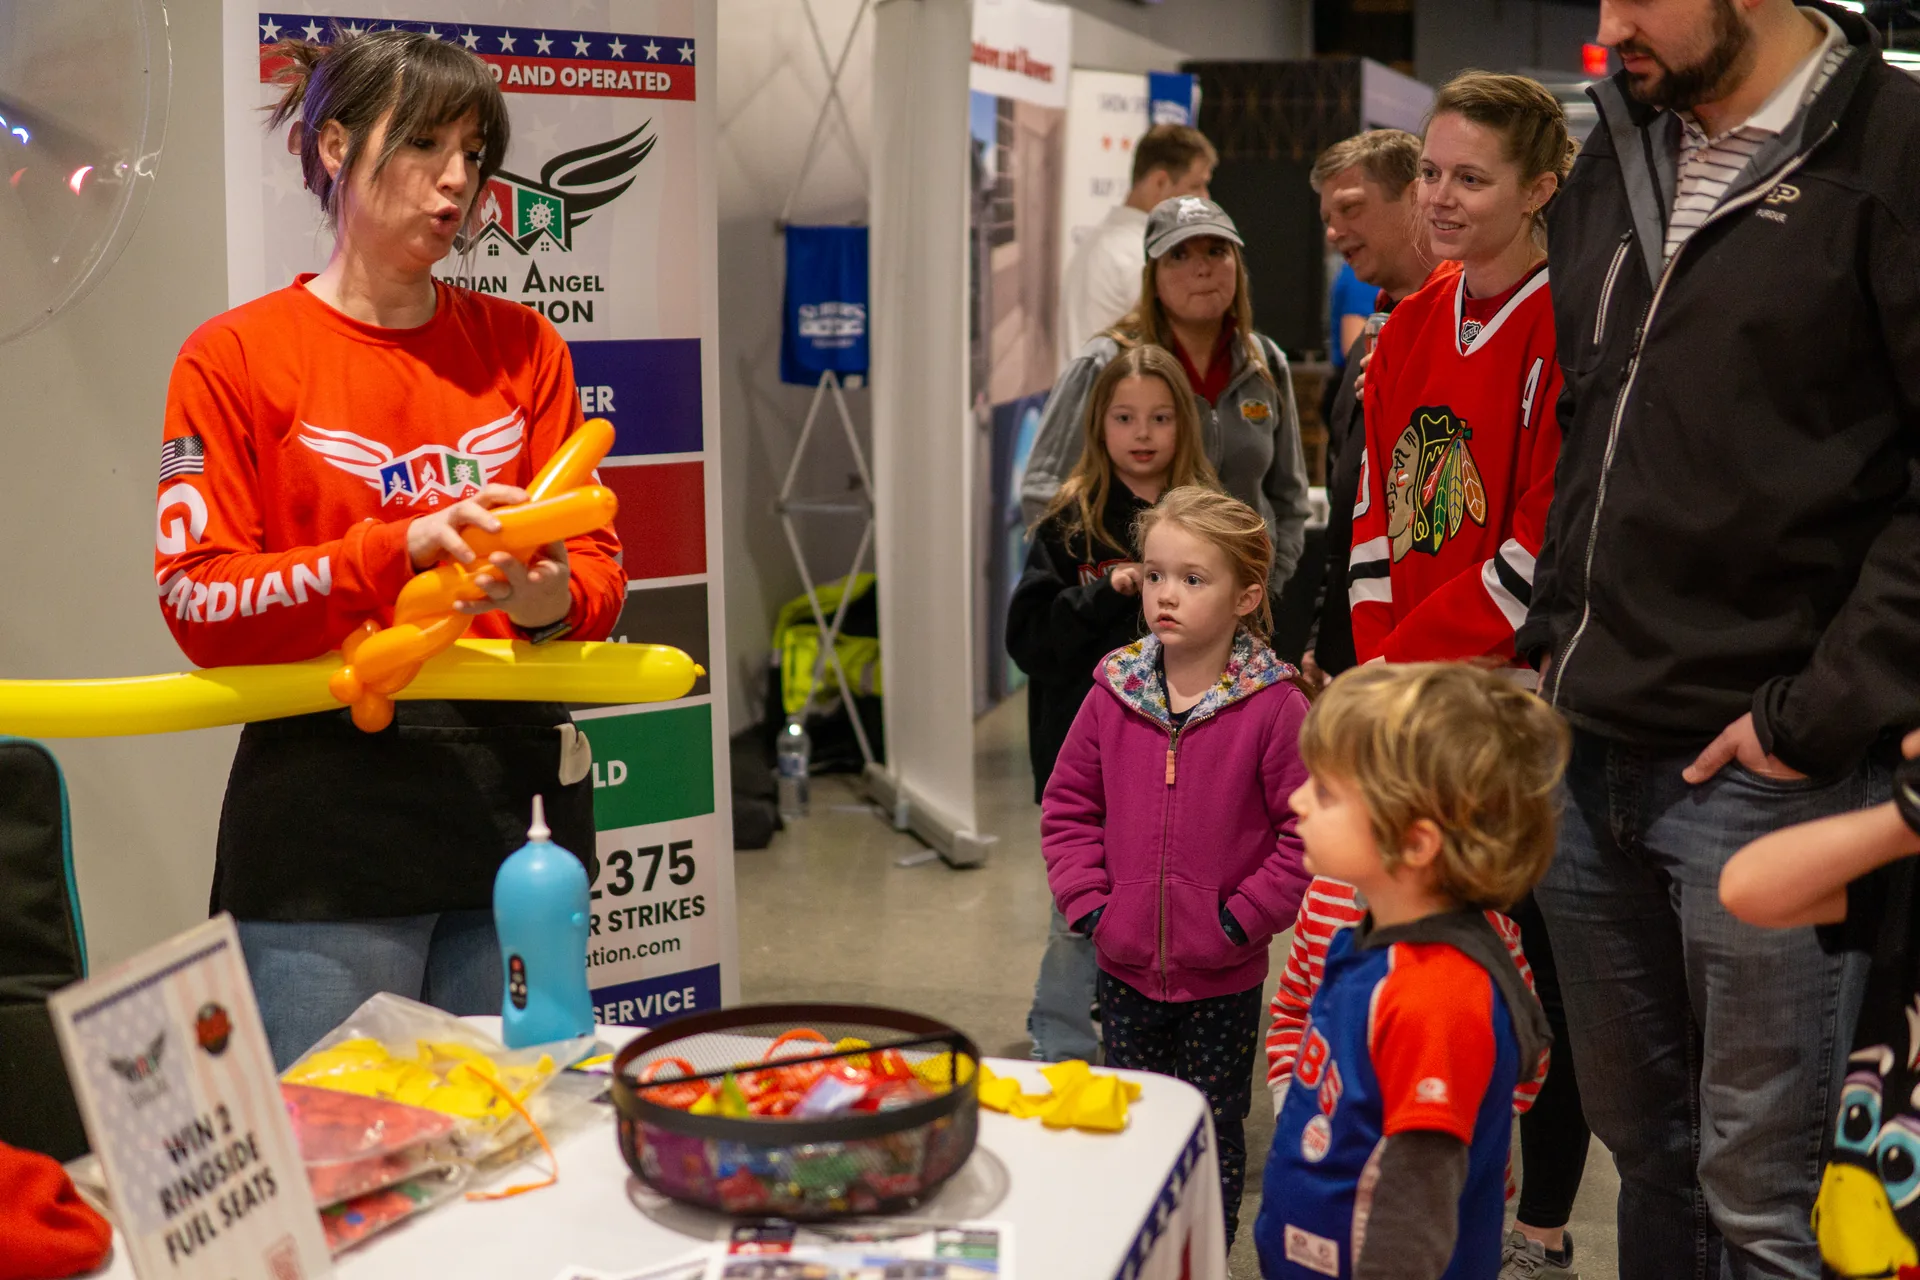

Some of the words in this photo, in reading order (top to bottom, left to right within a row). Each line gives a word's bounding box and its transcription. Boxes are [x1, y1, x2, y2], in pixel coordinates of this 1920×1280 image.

[507, 64, 556, 87] AND
[560, 66, 671, 92] OPERATED
[434, 275, 507, 293] RDIAN
[521, 259, 605, 293] ANGEL
[576, 385, 616, 413] ER
[607, 895, 706, 933] STRIKES
[592, 987, 697, 1025] SERVICE
[163, 1113, 215, 1165] WIN
[215, 1102, 233, 1134] 2
[159, 1130, 260, 1220] RINGSIDE
[164, 1210, 217, 1266] FUEL
[217, 1166, 279, 1229] SEATS
